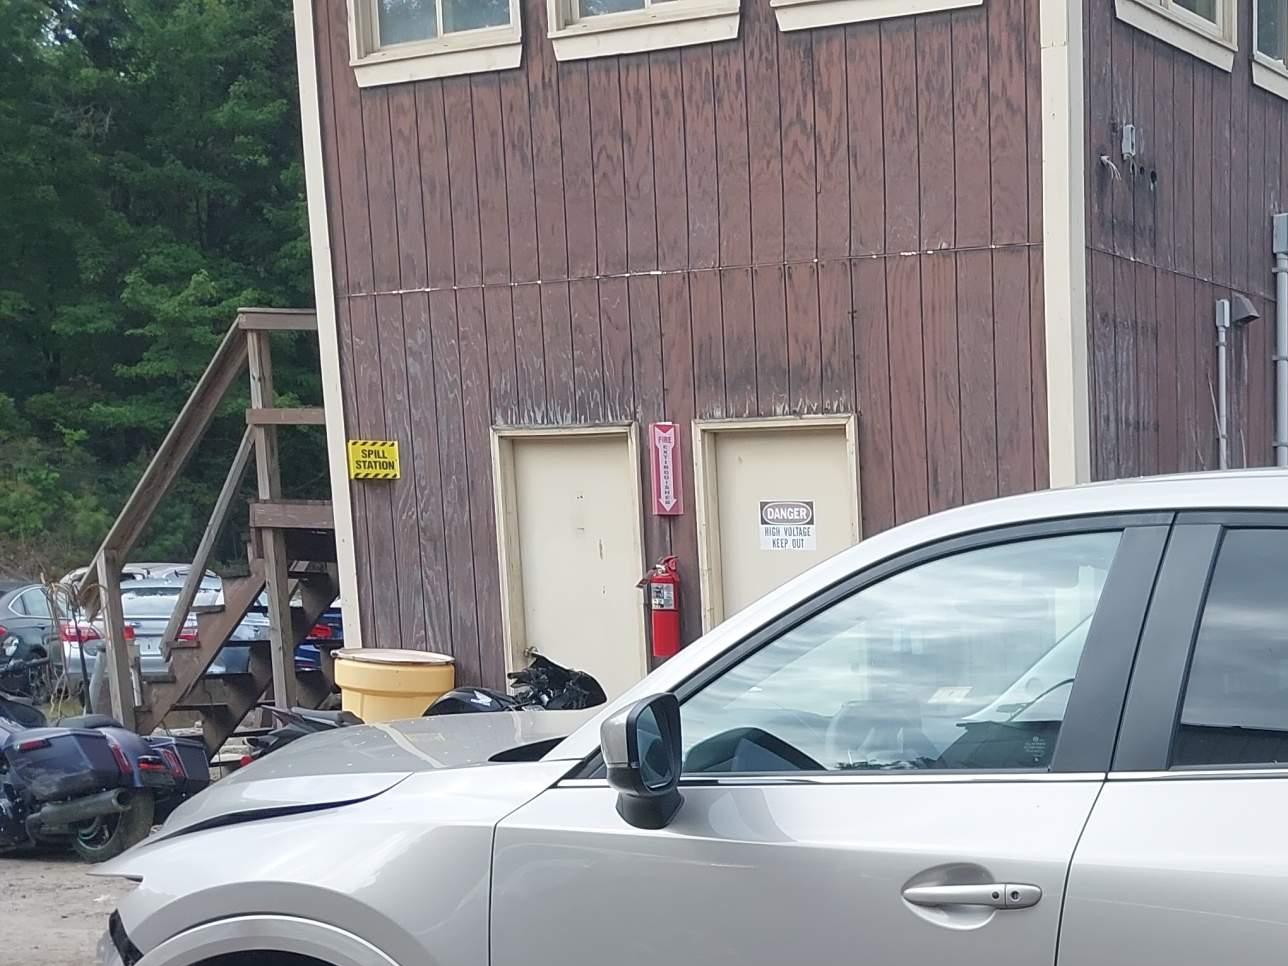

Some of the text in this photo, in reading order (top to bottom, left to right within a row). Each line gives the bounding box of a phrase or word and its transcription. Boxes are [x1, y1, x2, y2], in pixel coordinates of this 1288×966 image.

[658, 436, 672, 444] FIRE
[361, 449, 388, 459] SPILL
[355, 460, 395, 470] STATION
[766, 507, 808, 520] DANGER
[764, 526, 811, 537] HIGH VOLTAGE
[772, 538, 805, 549] KEEP OUT
